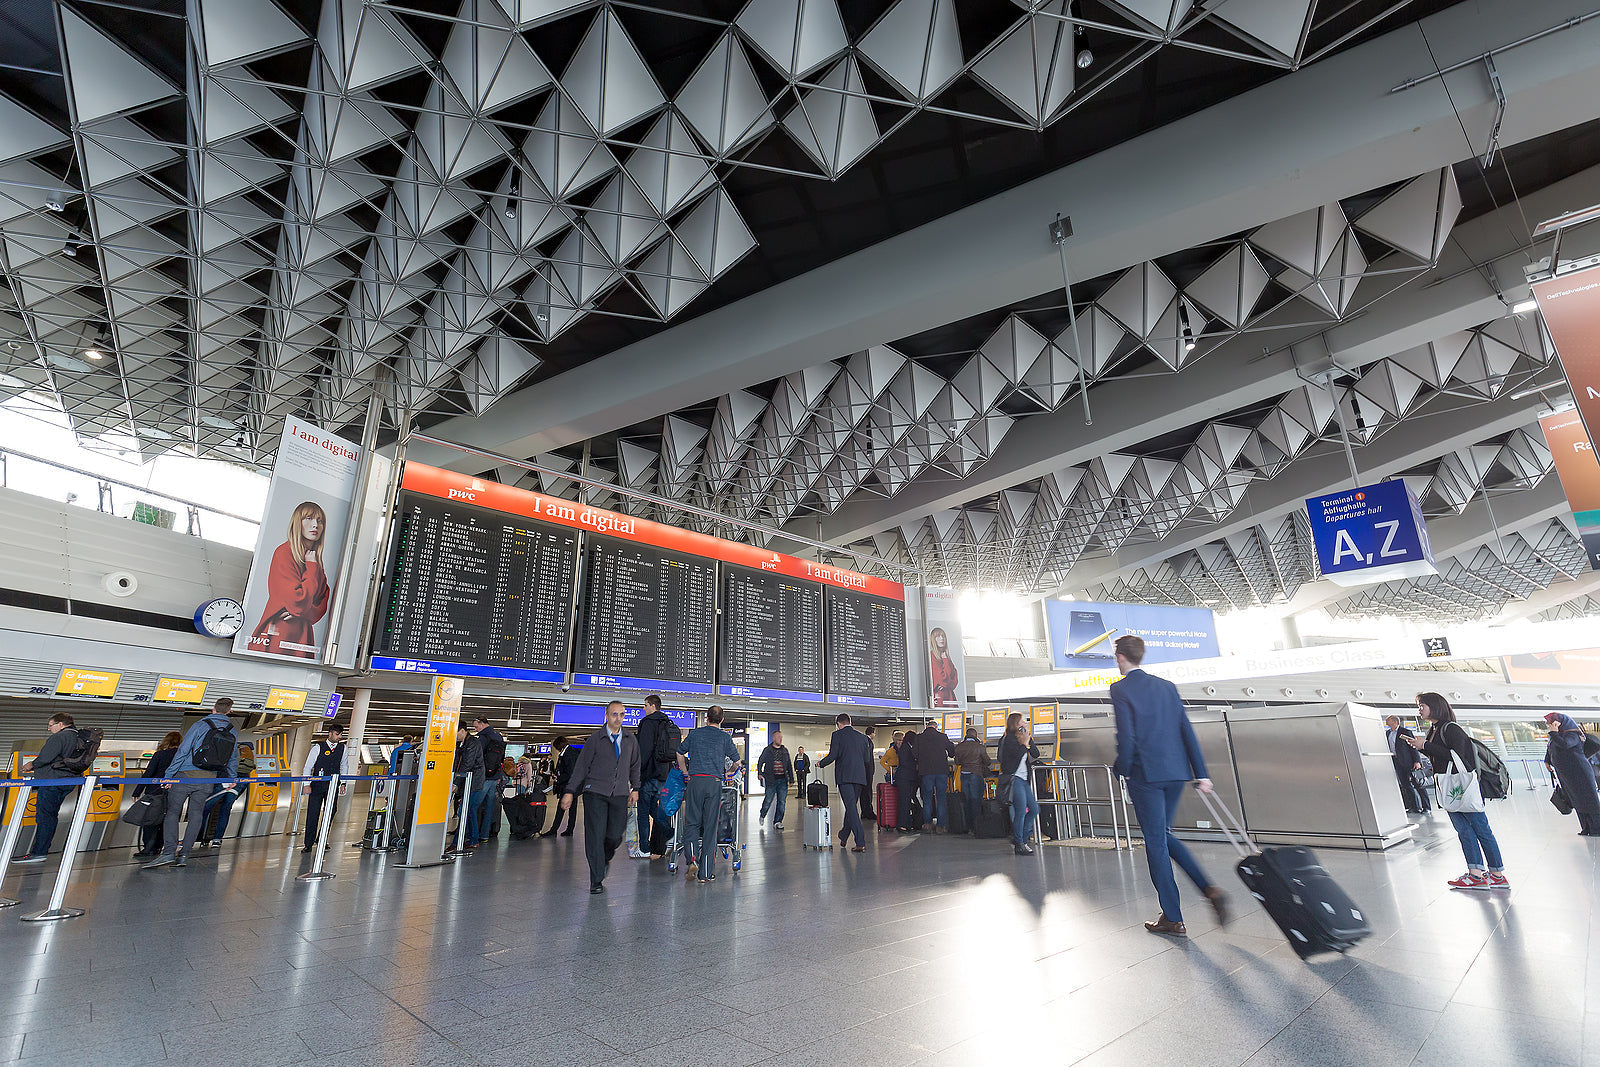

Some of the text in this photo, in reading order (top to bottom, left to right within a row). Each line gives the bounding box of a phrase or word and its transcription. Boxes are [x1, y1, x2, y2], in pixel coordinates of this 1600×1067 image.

[292, 425, 358, 462] I am digital
[448, 488, 476, 502] pwc
[1321, 495, 1353, 507] Terminal
[532, 496, 636, 534] I am digital
[1323, 502, 1366, 515] Abflughalle
[1325, 506, 1382, 523] Departures hall
[762, 561, 777, 570] pwc
[808, 563, 866, 588] I am digital
[1168, 630, 1193, 638] powerful
[1246, 652, 1325, 672] Business
[1330, 649, 1385, 664] Class
[77, 673, 109, 681] Lufthansa
[29, 686, 49, 695] 262
